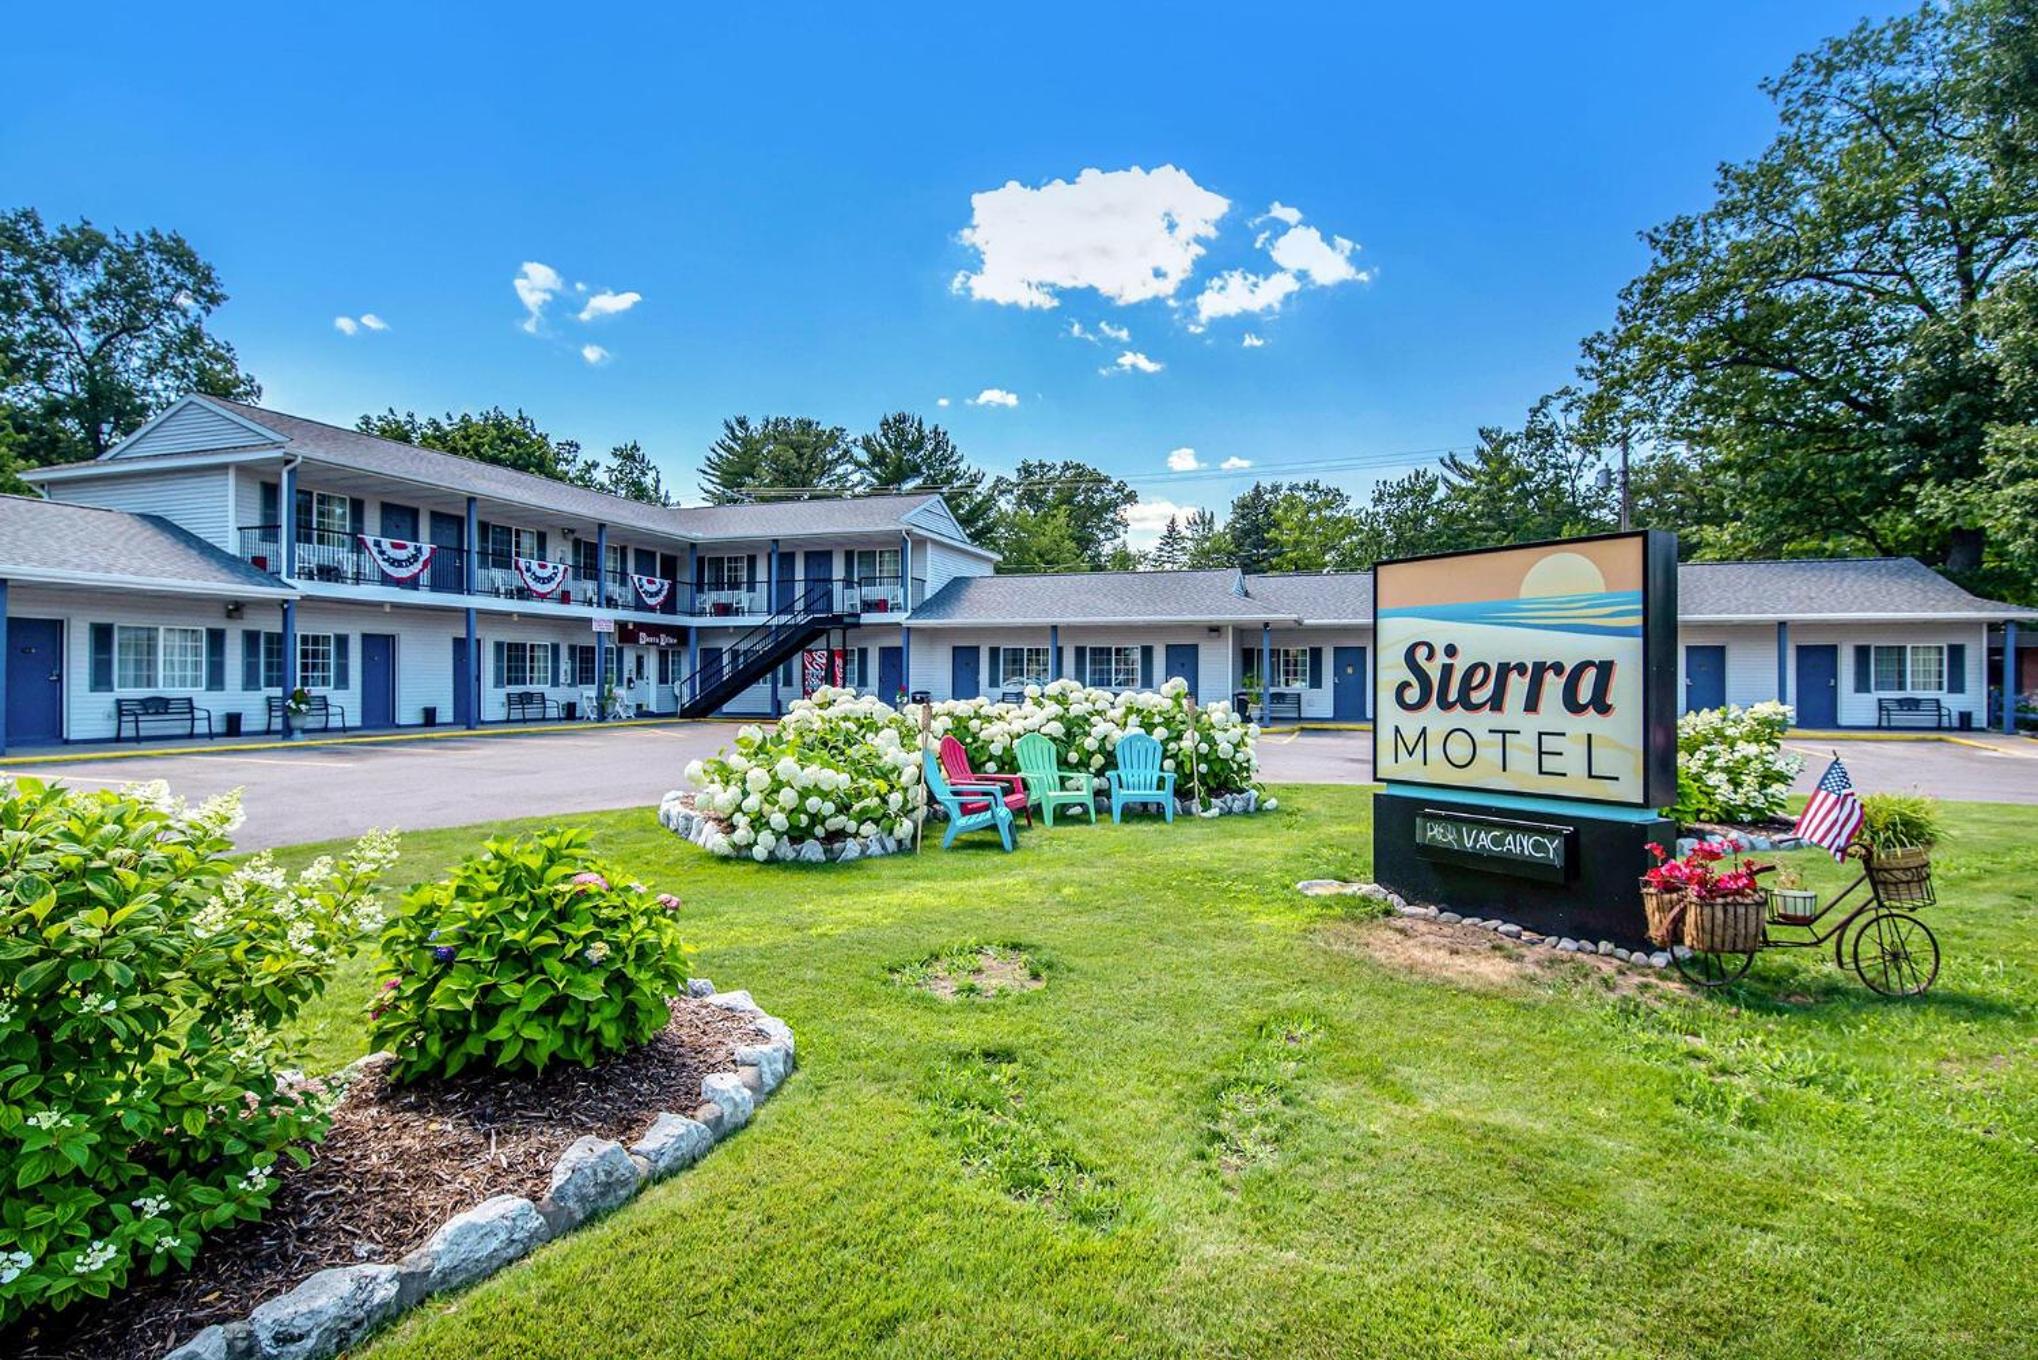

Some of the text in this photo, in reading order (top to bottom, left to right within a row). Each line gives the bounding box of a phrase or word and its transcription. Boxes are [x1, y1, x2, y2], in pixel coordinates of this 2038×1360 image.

[1395, 641, 1617, 717] Sierra
[1394, 725, 1619, 781] MOTEL
[1462, 827, 1559, 862] VACANCY
